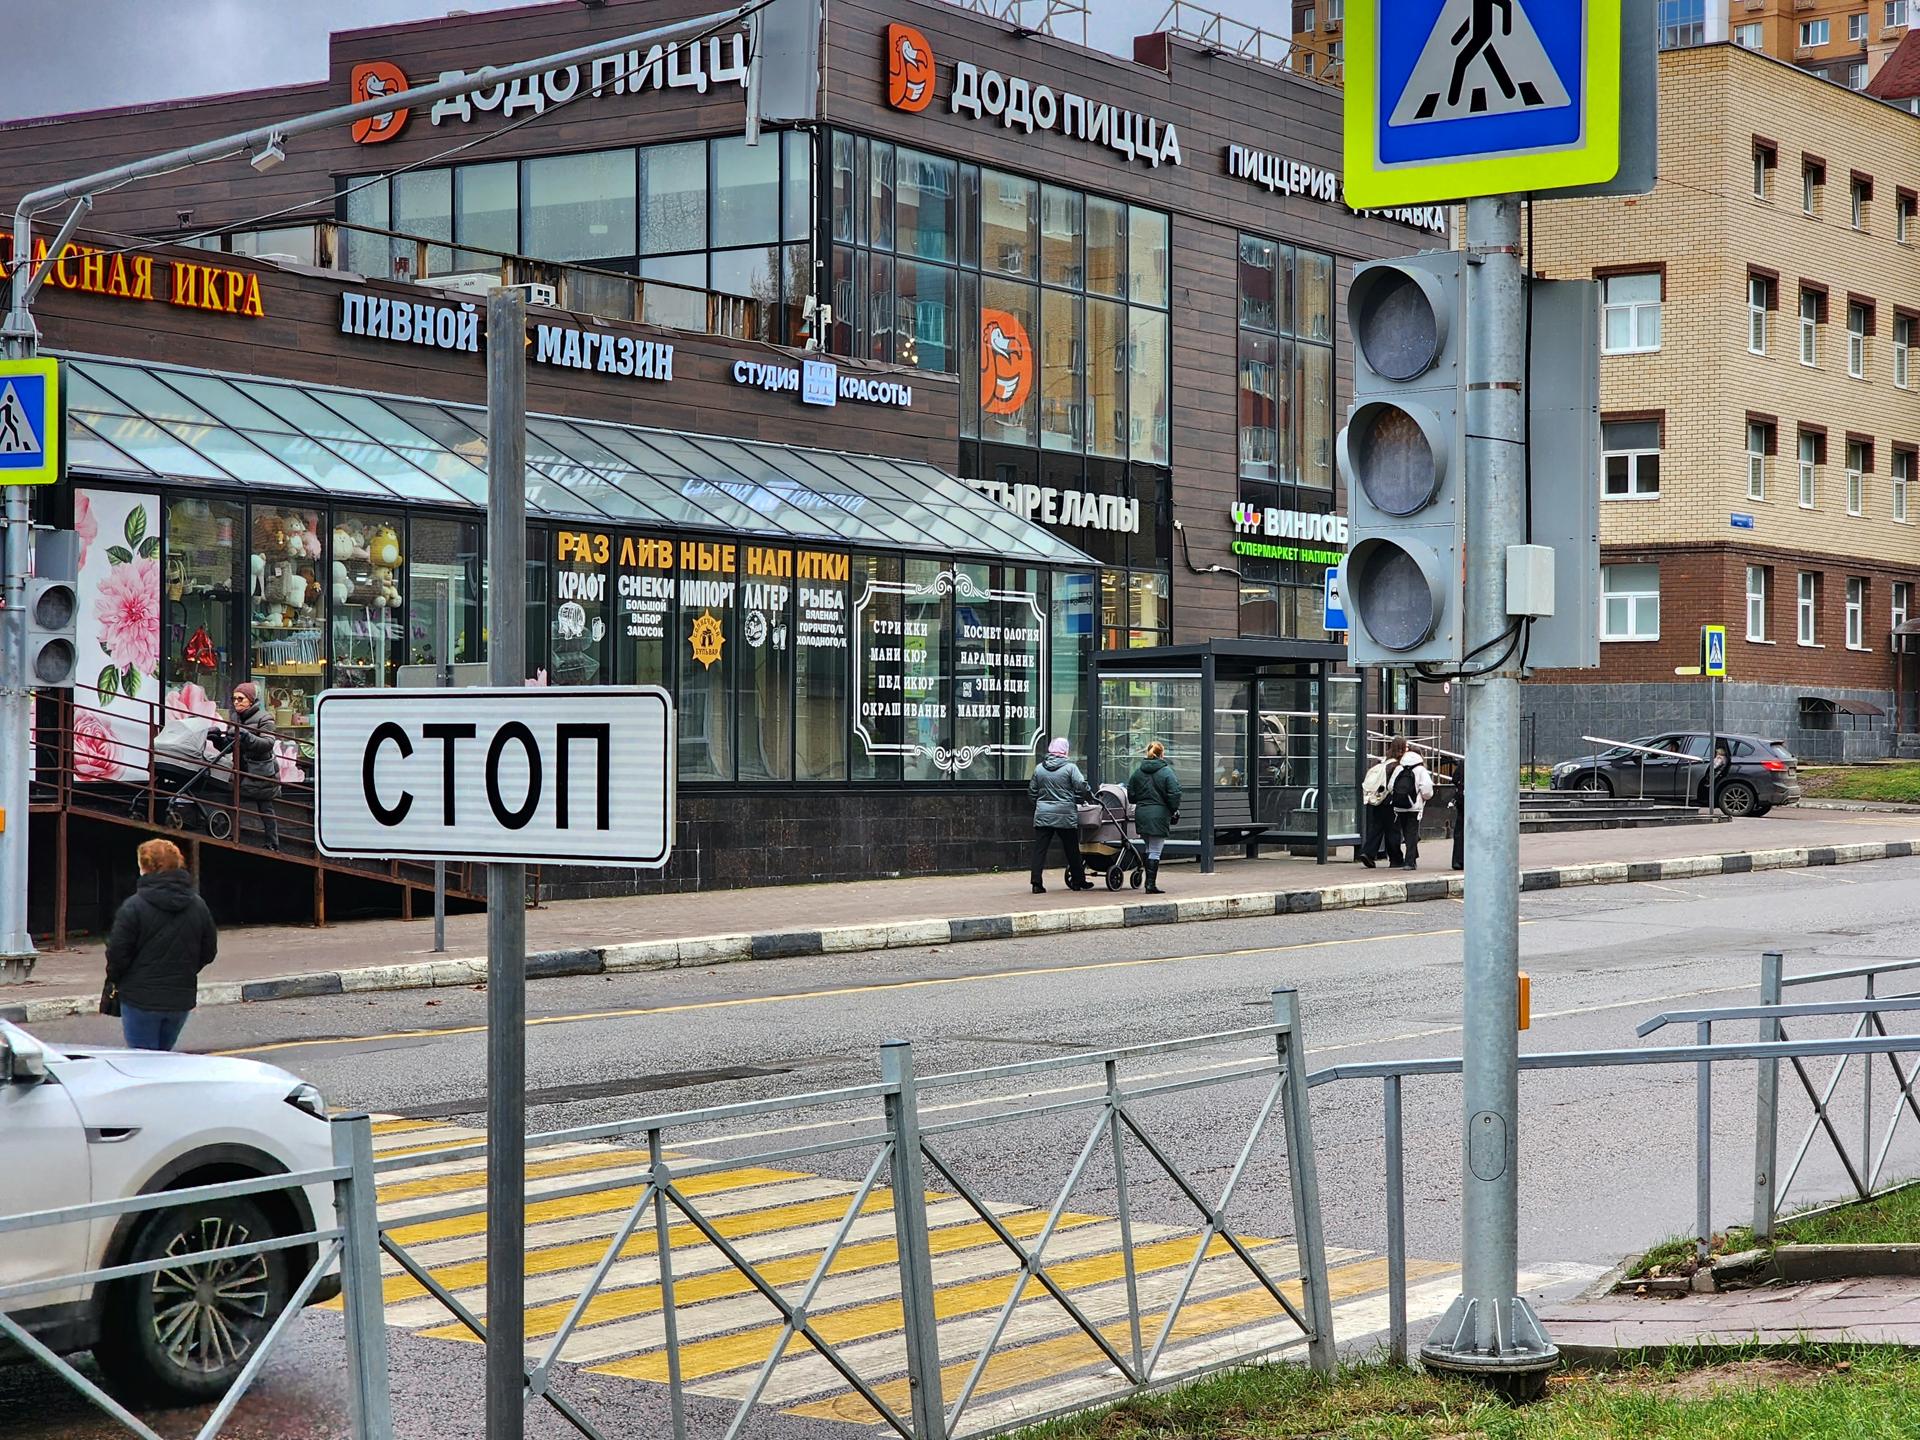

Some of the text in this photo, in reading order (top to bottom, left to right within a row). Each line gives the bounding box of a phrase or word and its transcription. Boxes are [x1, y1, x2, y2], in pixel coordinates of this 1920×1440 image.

[431, 33, 750, 126] ДОДО ПИЦЦ
[952, 61, 1181, 168] ДОДО ПИЦЦА
[1228, 144, 1336, 202] ПИЦЦЕРИЯ
[169, 261, 265, 317] ИКРА
[341, 291, 674, 381] ПИВНОЙ МАГАЗИН
[732, 359, 799, 391] СТУДИЯ
[839, 376, 912, 407] КРАСОТЫ
[957, 477, 1140, 534] ТЫРЕ ЛАПЫ
[1233, 541, 1345, 565] СУПЕРМАРКЕТ НАПИТКО
[558, 571, 844, 611] КРАФТ СНЕКИ ИМПОРТ ЛАГЕР РЫБА
[625, 599, 667, 612] БОЛЬШОЙ
[631, 613, 662, 625] ВЫБОР
[805, 610, 839, 621] ВЯЛЕНАЯ
[627, 625, 664, 638] ЗАКУСОК
[799, 622, 844, 636] ГОРЯЧЕГО/К
[873, 620, 928, 637] СТРИЖКИ
[796, 635, 848, 648] ХОЛОДНОГО/К
[695, 648, 719, 656] БУЛЬВАР
[870, 648, 927, 664] МАНИКЮР
[960, 651, 1035, 668] НАРАЩИВАНИЕ
[878, 675, 935, 691] ПЕДИКЮР
[975, 678, 1030, 693] ЭПИЛЯЦИЯ
[862, 702, 947, 719] ОКРАШИВАНИЕ
[957, 704, 1036, 719] МАКИЯЖ БРОВИ
[362, 720, 610, 831] СТОП
